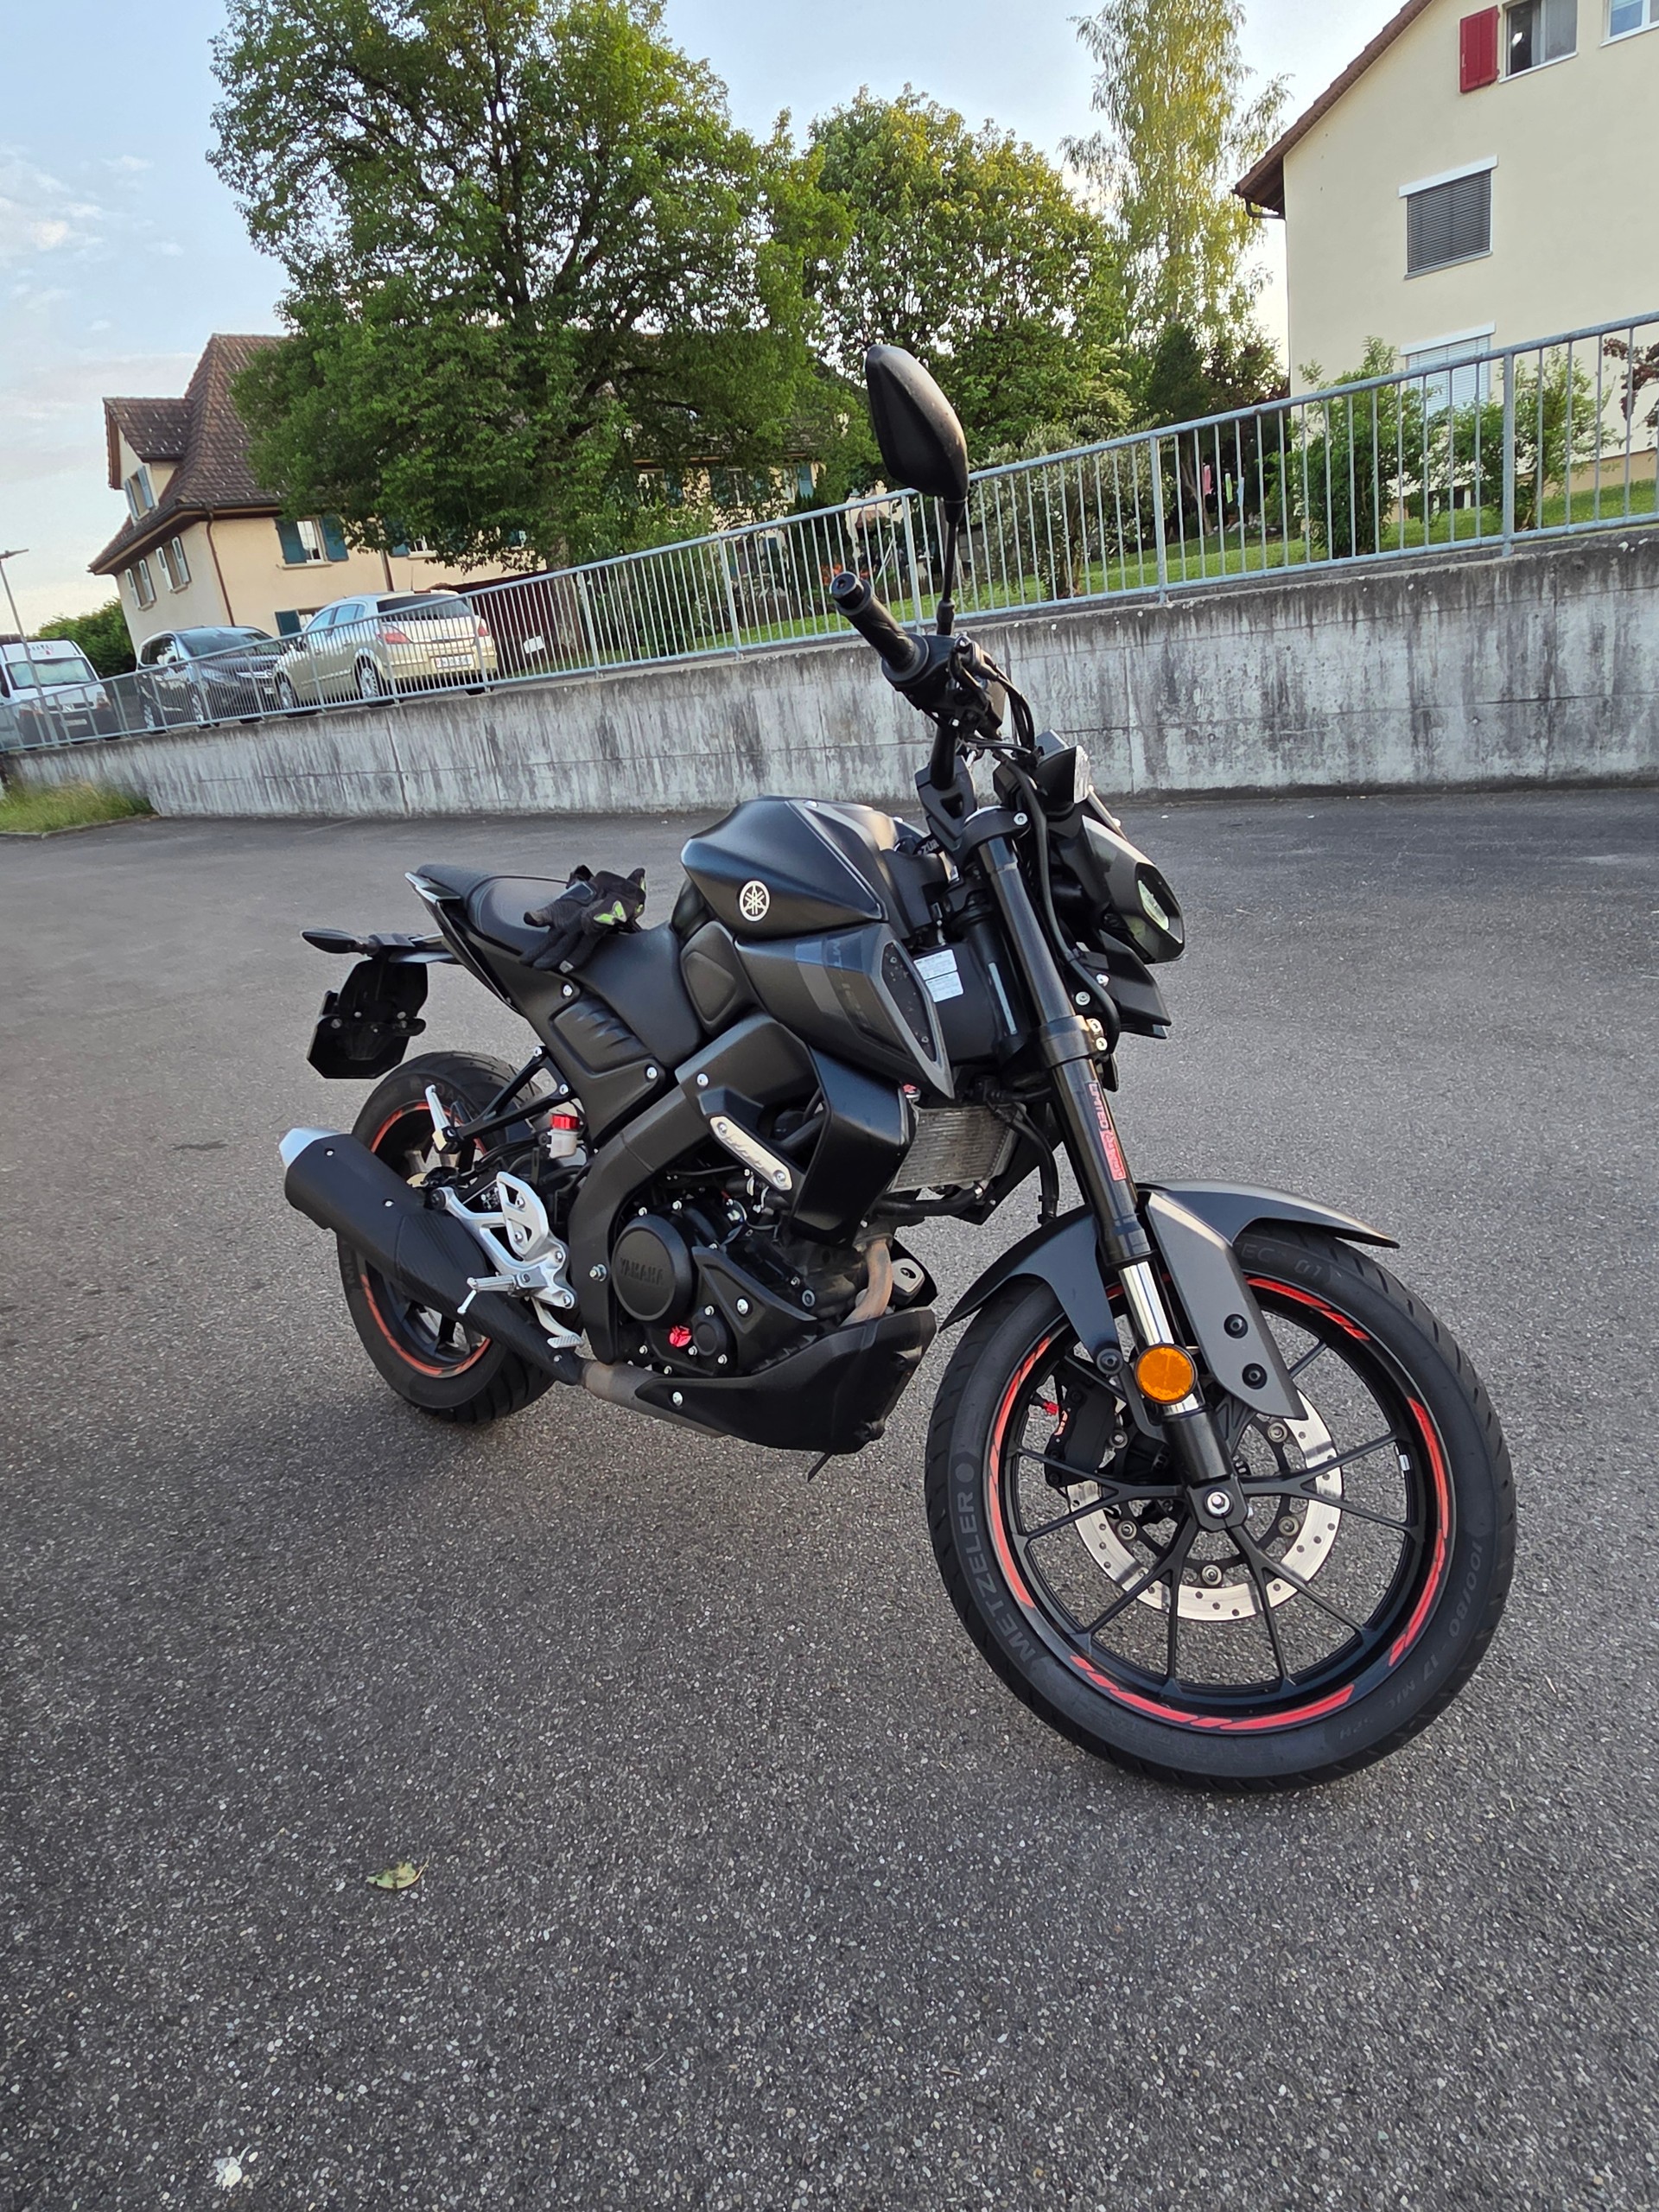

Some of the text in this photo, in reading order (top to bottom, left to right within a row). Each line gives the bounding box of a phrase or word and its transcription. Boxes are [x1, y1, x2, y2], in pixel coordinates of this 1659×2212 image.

[620, 1257, 665, 1286] YAMAHA
[954, 1490, 1036, 1662] METZELER
[1448, 1539, 1484, 1638] 100/80
